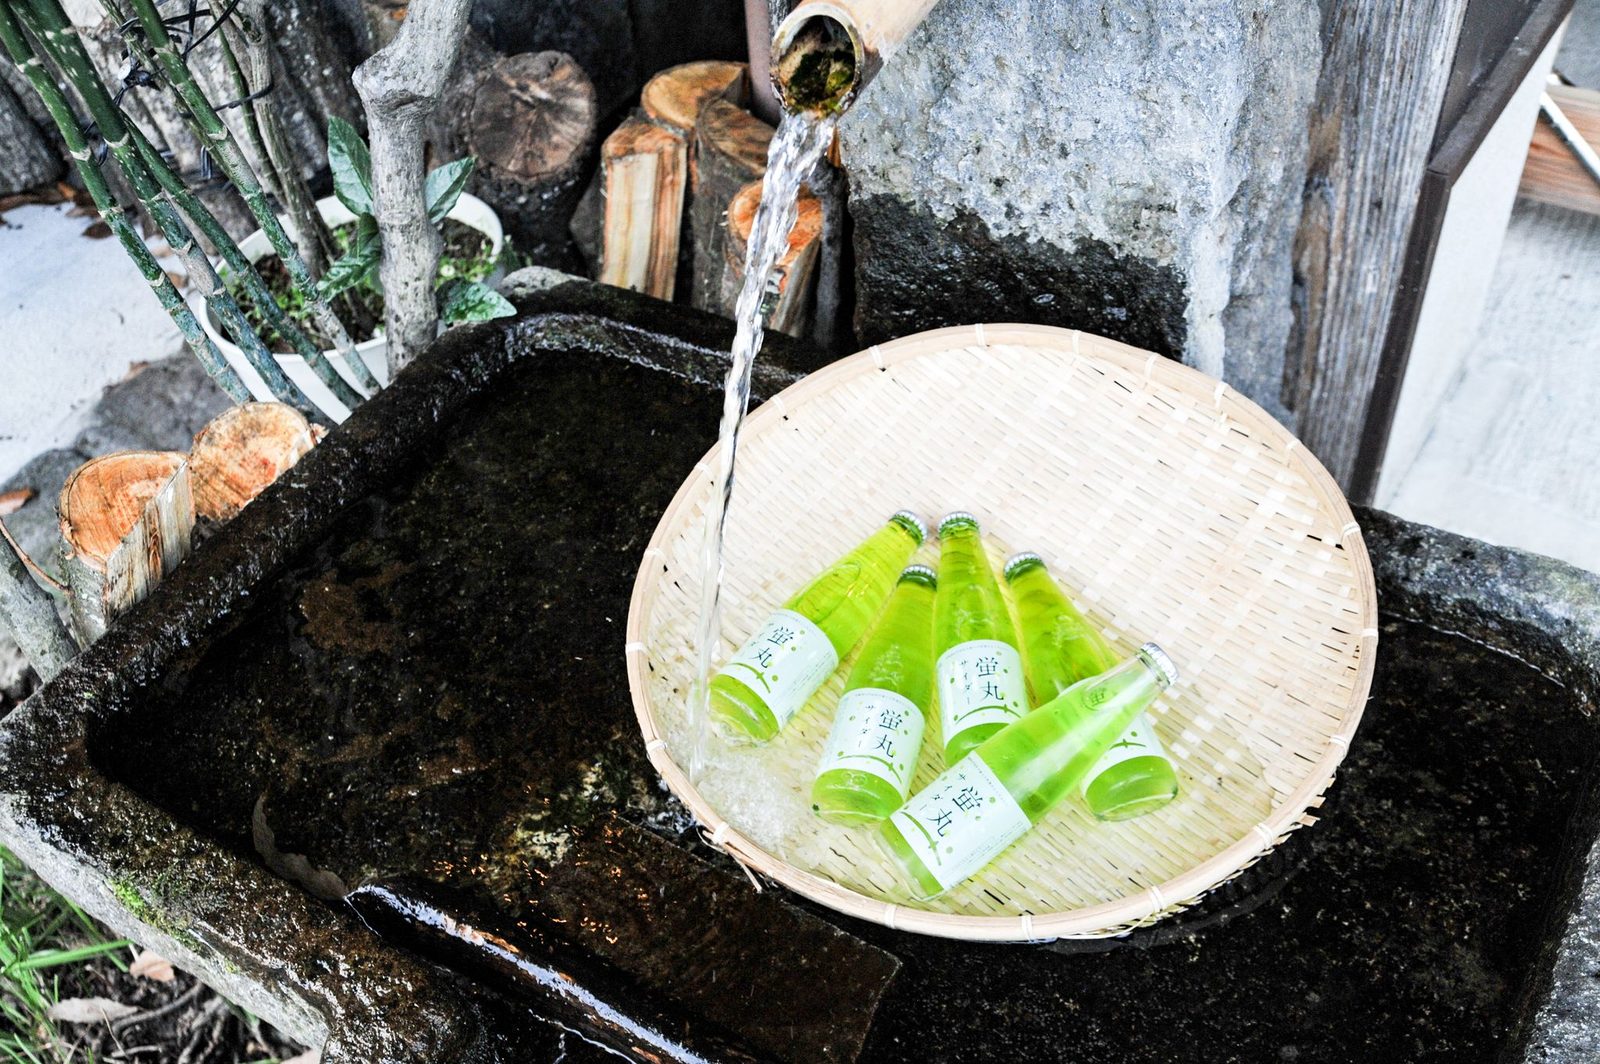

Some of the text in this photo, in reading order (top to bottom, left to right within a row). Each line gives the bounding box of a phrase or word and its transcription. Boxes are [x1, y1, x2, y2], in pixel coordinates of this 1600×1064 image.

[748, 626, 795, 668] 蛍丸
[975, 656, 1004, 701] 蛍丸
[874, 709, 903, 758] 蛍丸
[919, 772, 967, 812] サイダー
[926, 786, 984, 838] 蛍丸
